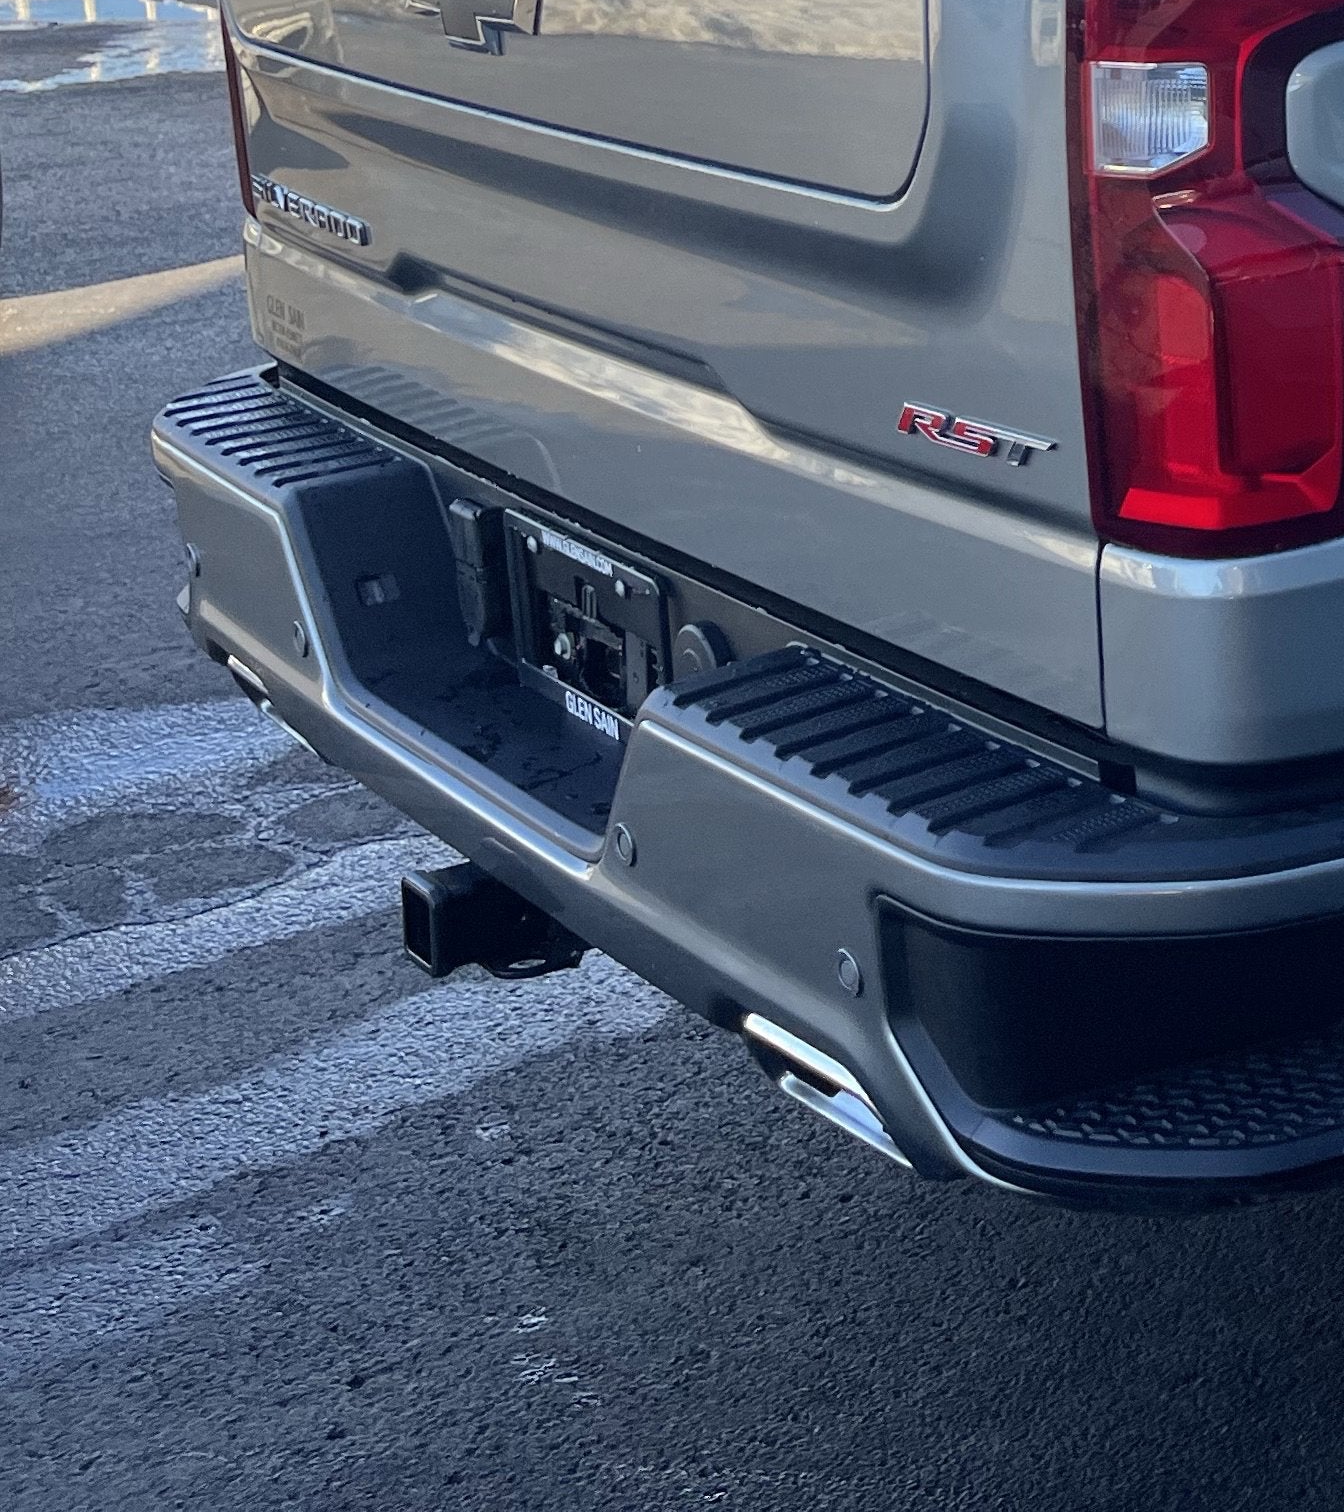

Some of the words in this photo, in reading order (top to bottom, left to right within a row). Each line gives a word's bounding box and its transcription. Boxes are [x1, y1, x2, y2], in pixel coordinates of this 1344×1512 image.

[898, 401, 1058, 467] RST
[565, 690, 593, 725] GLEN
[593, 707, 620, 741] SAIN
